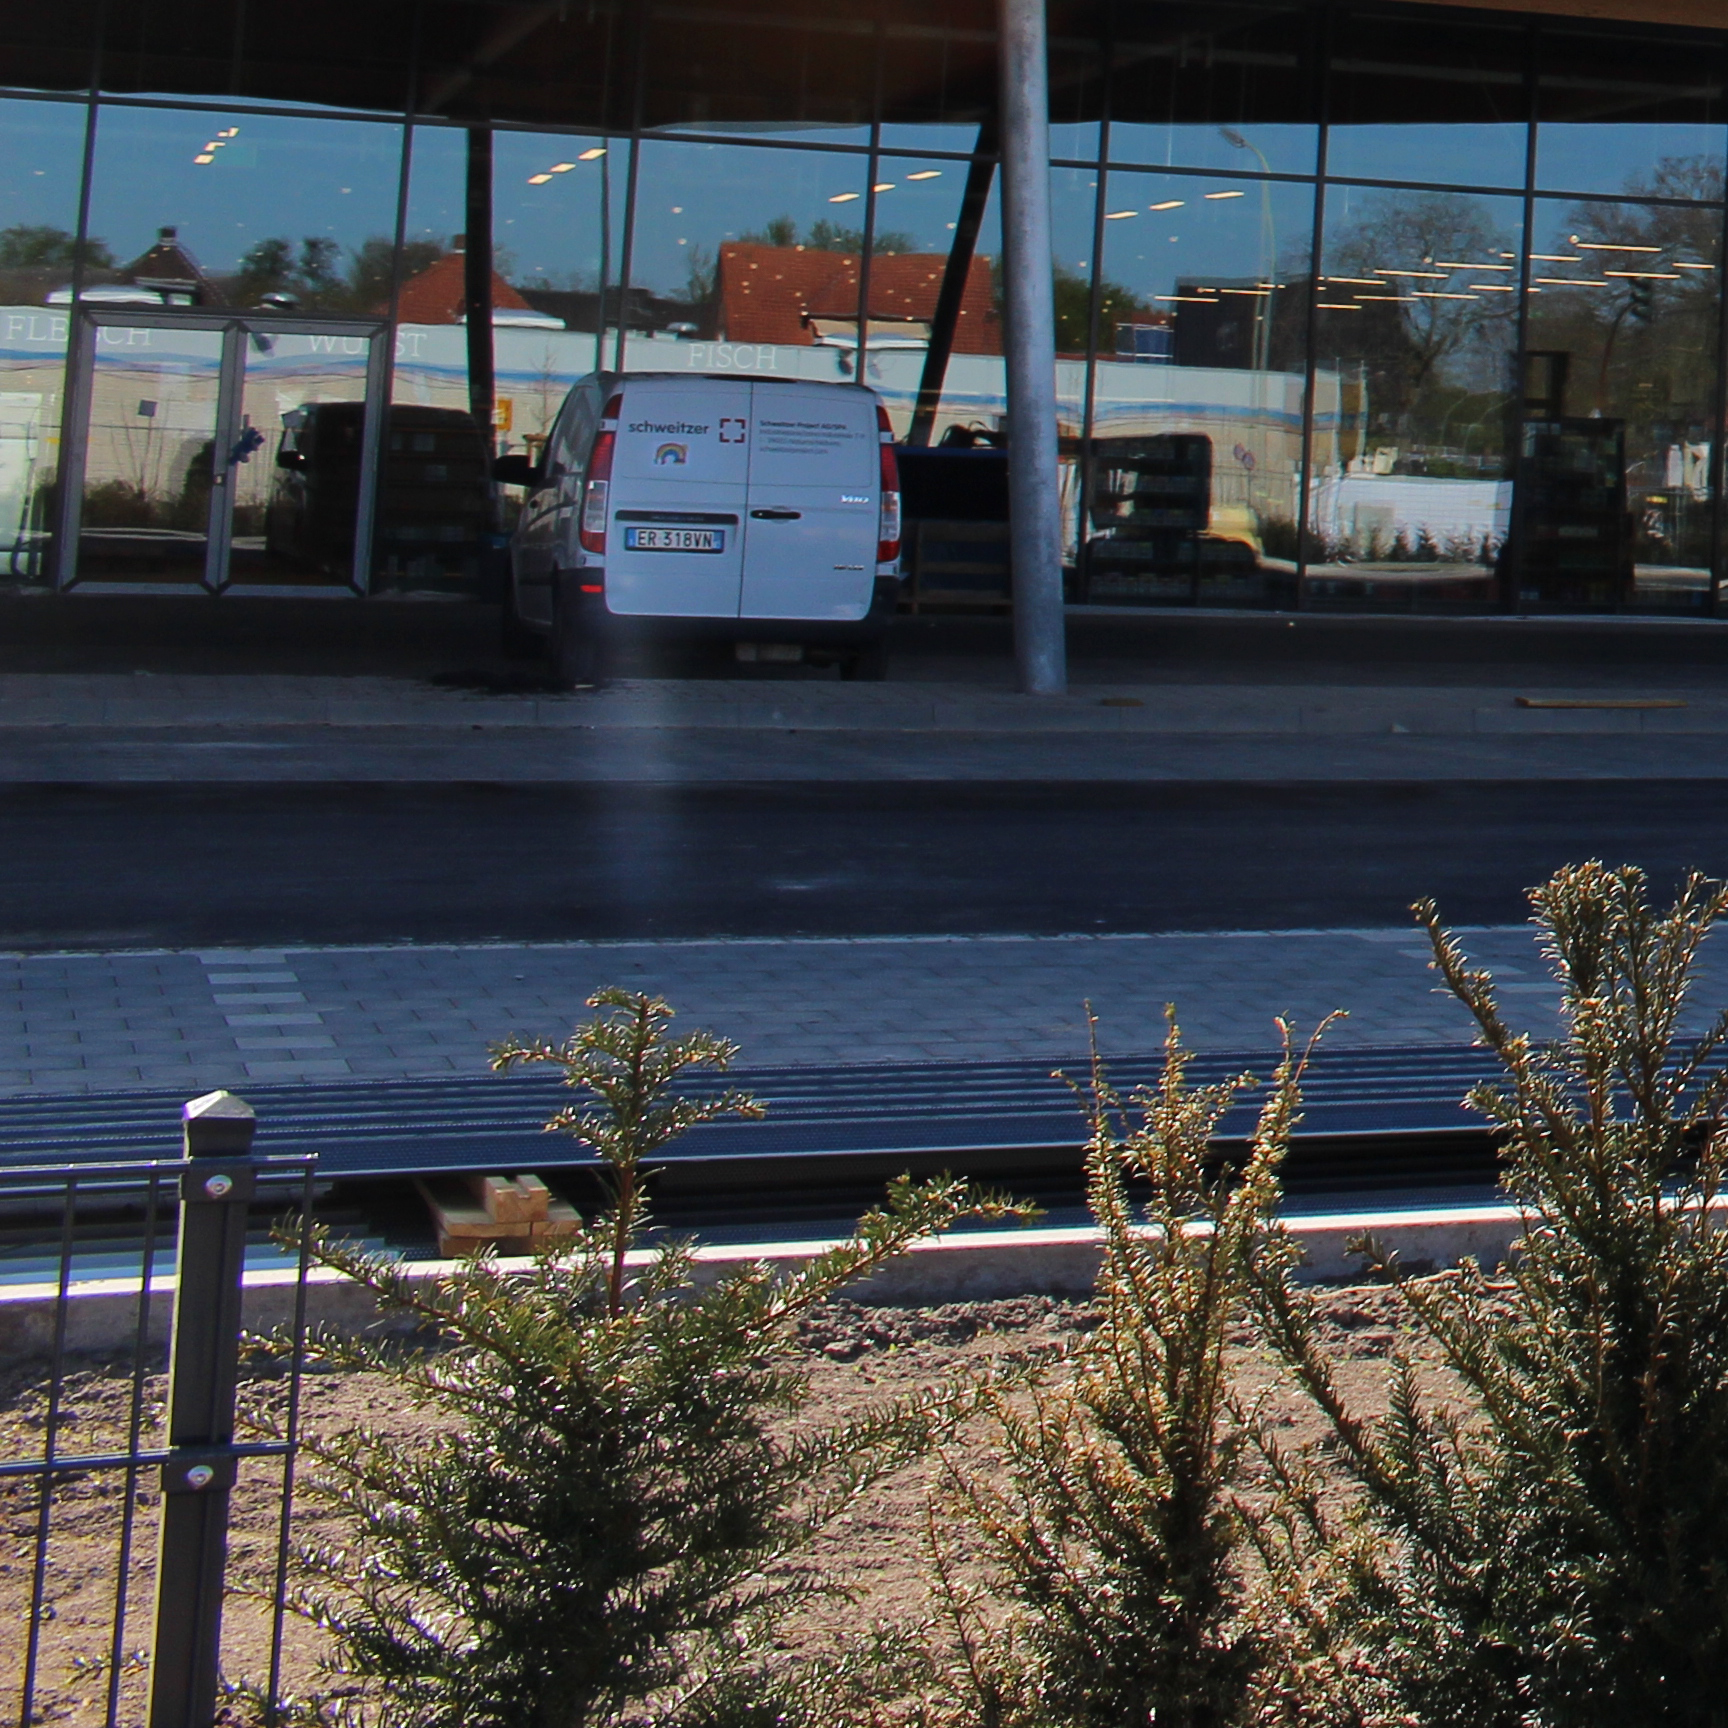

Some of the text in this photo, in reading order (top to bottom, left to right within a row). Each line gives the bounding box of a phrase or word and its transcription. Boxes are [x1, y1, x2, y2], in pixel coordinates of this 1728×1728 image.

[6, 315, 152, 346] FLECH
[309, 332, 428, 358] WUST
[688, 343, 778, 370] FISCH
[628, 420, 710, 434] schweitzer
[637, 531, 713, 548] ER 318VN
